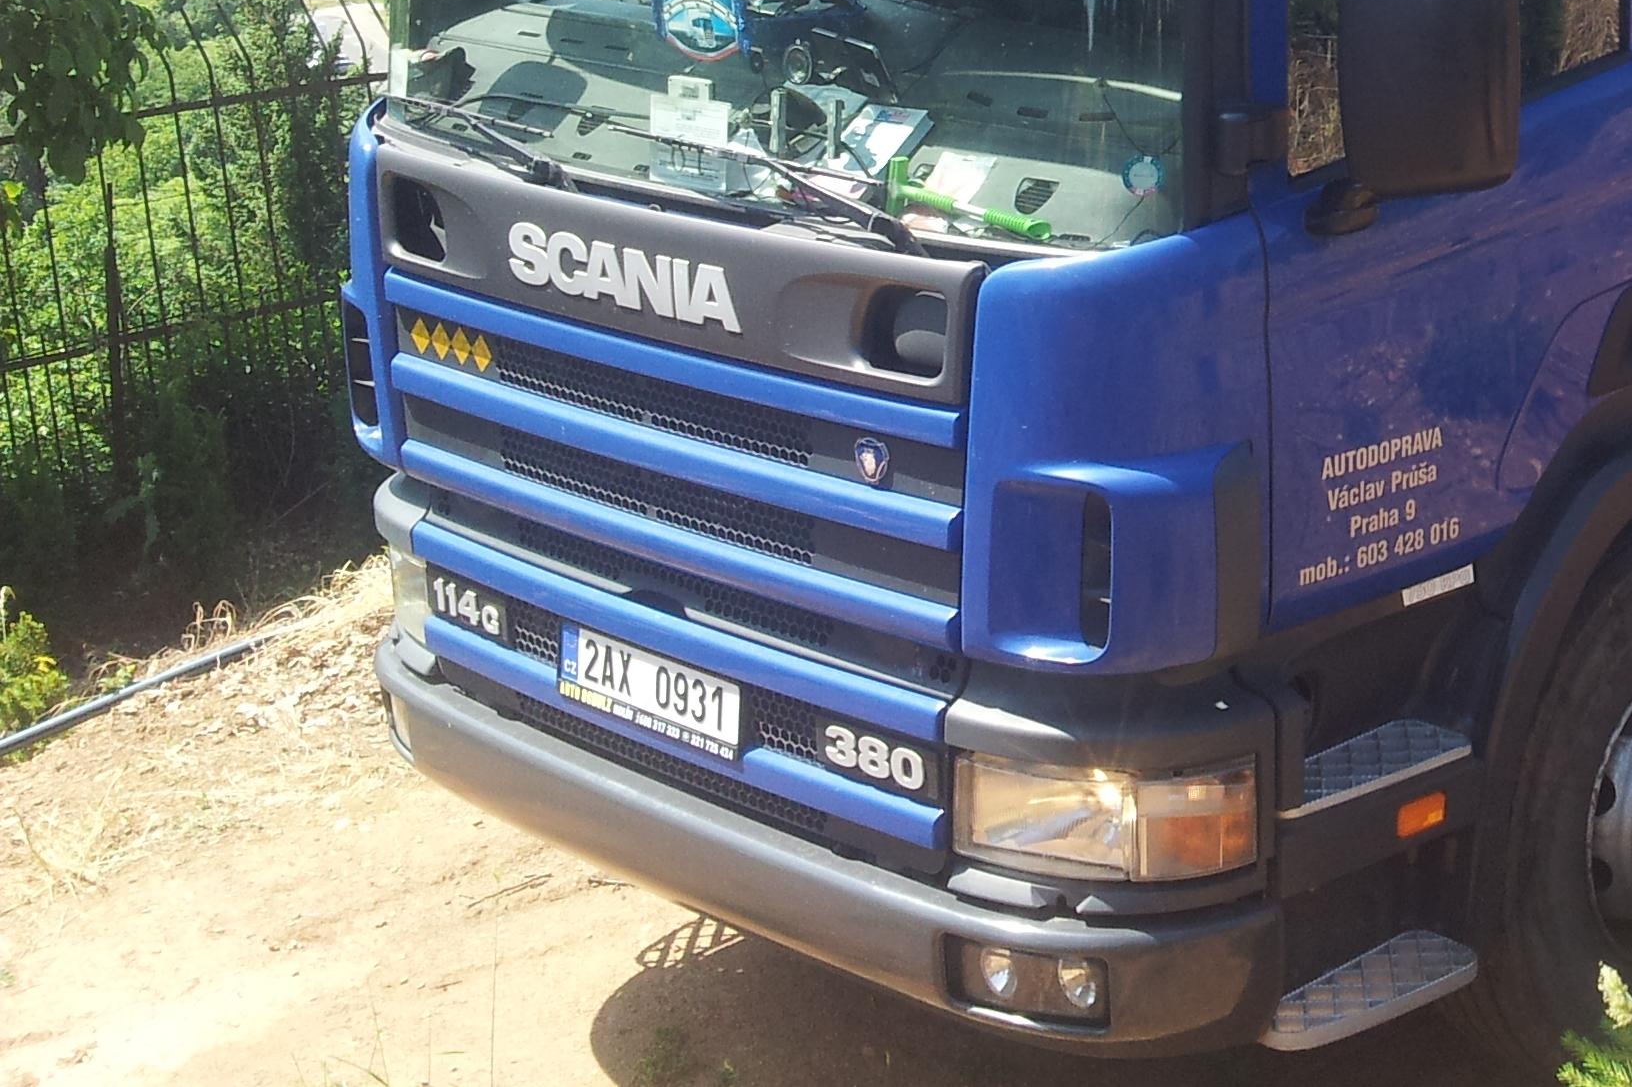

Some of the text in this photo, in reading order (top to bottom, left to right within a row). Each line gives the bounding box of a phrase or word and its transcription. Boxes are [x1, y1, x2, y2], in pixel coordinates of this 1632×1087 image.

[508, 222, 742, 334] SCANIA
[1321, 426, 1443, 480] AUTODOPRAVA
[1327, 479, 1385, 511] Václav
[1350, 498, 1416, 538] Praha 9
[1356, 540, 1388, 569] 603
[1394, 528, 1424, 556] 428
[1430, 517, 1460, 545] 016
[559, 680, 581, 701] AUTO
[564, 658, 577, 675] CZ
[584, 639, 724, 731] 2AX 0931
[825, 724, 925, 790] 380
